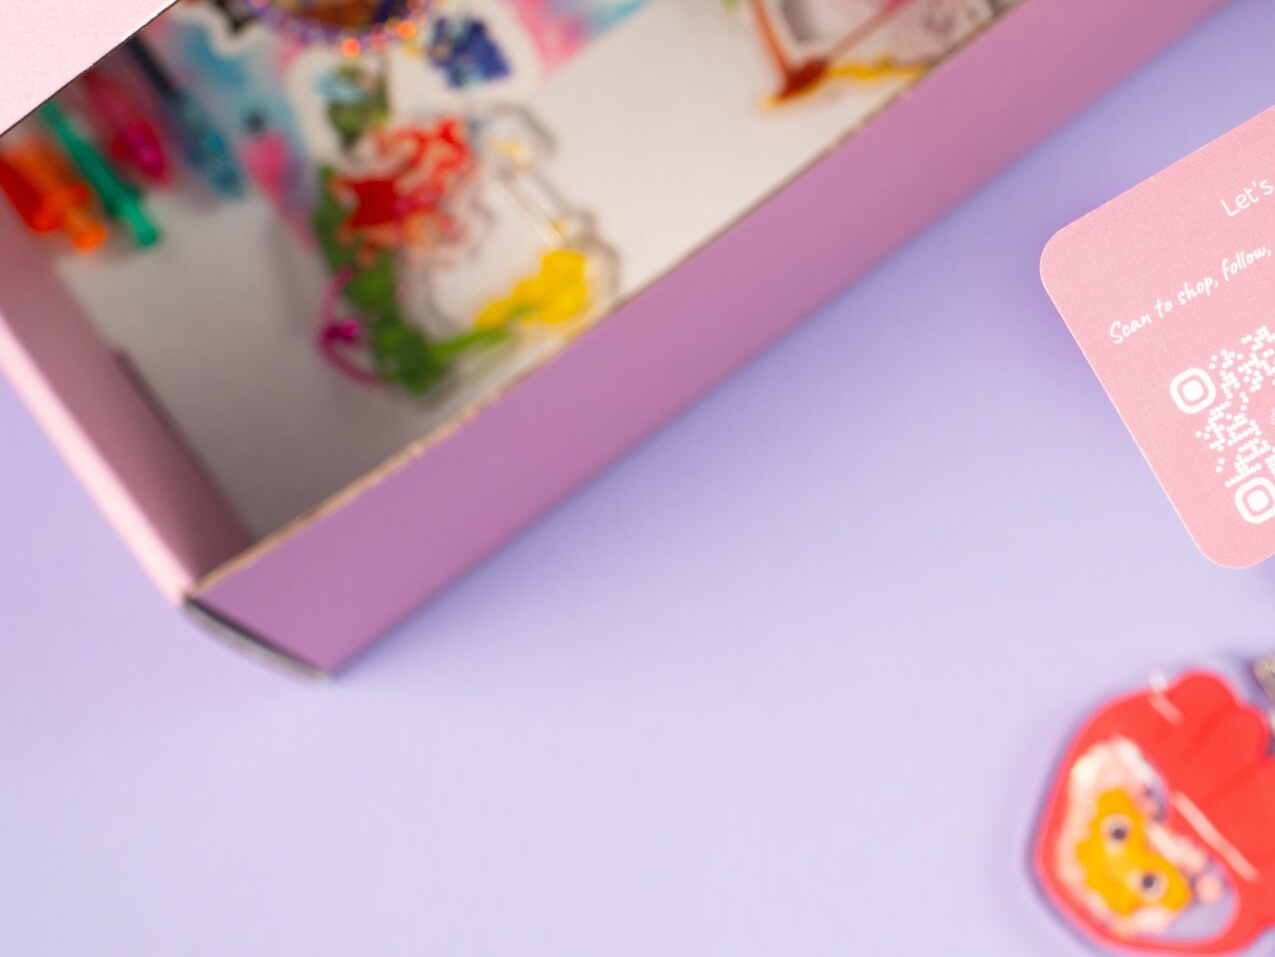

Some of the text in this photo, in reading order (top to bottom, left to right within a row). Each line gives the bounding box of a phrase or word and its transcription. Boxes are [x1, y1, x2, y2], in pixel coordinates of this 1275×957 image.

[1221, 180, 1273, 216] Let's
[1110, 315, 1151, 344] Scan
[1155, 299, 1172, 318] to
[1178, 277, 1218, 305] shop,
[1222, 247, 1271, 281] follow,
